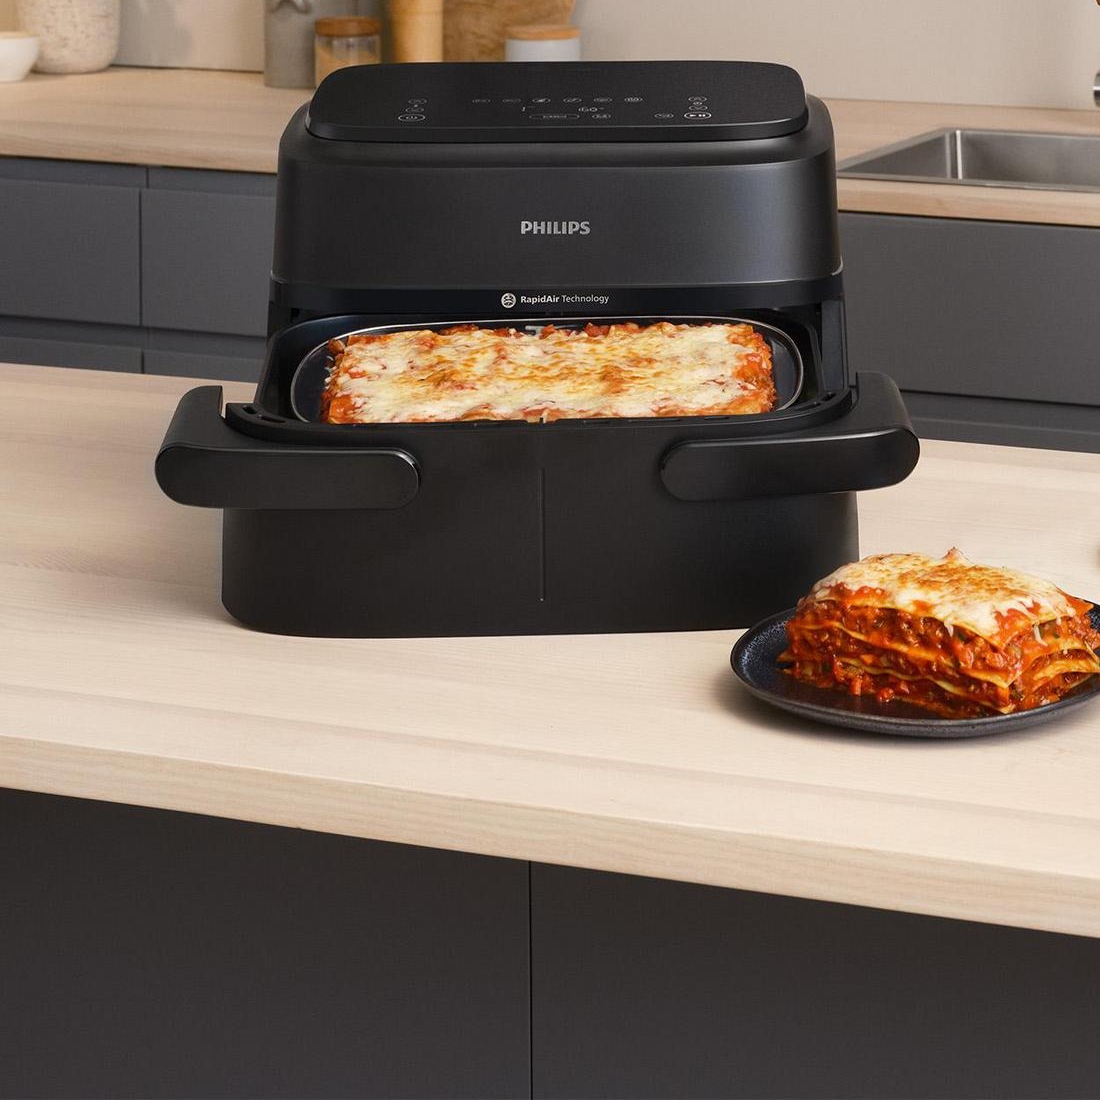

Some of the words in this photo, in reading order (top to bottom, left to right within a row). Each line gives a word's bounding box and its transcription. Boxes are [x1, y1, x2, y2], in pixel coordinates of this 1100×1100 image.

[520, 220, 591, 235] PHILIPS
[520, 294, 560, 305] RapidAir
[561, 294, 610, 305] Technology
